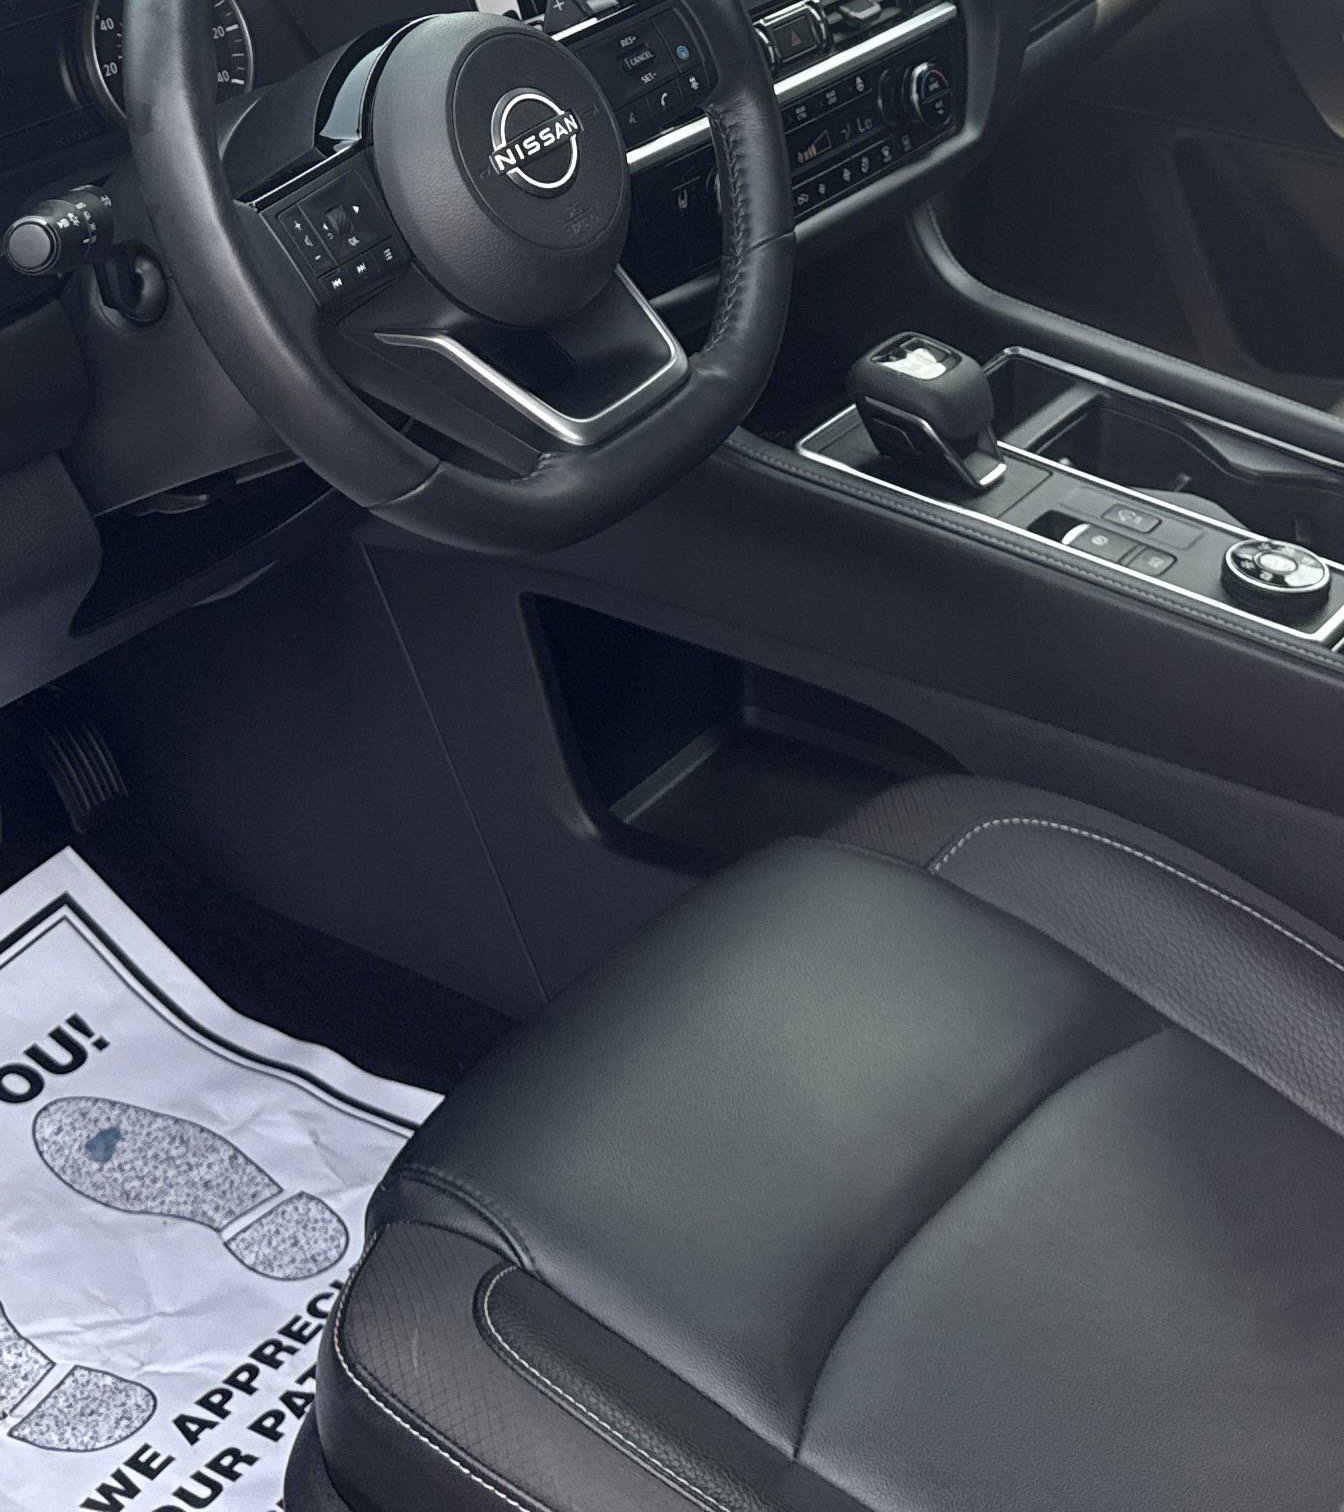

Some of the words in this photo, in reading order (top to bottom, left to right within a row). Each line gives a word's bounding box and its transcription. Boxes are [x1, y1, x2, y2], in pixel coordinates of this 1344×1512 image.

[99, 18, 115, 31] 40
[212, 25, 225, 40] 20
[629, 50, 654, 66] CANCEL
[103, 62, 118, 77] 20
[216, 70, 230, 83] 40
[494, 113, 579, 171] NISSAN
[79, 1442, 176, 1512] WE
